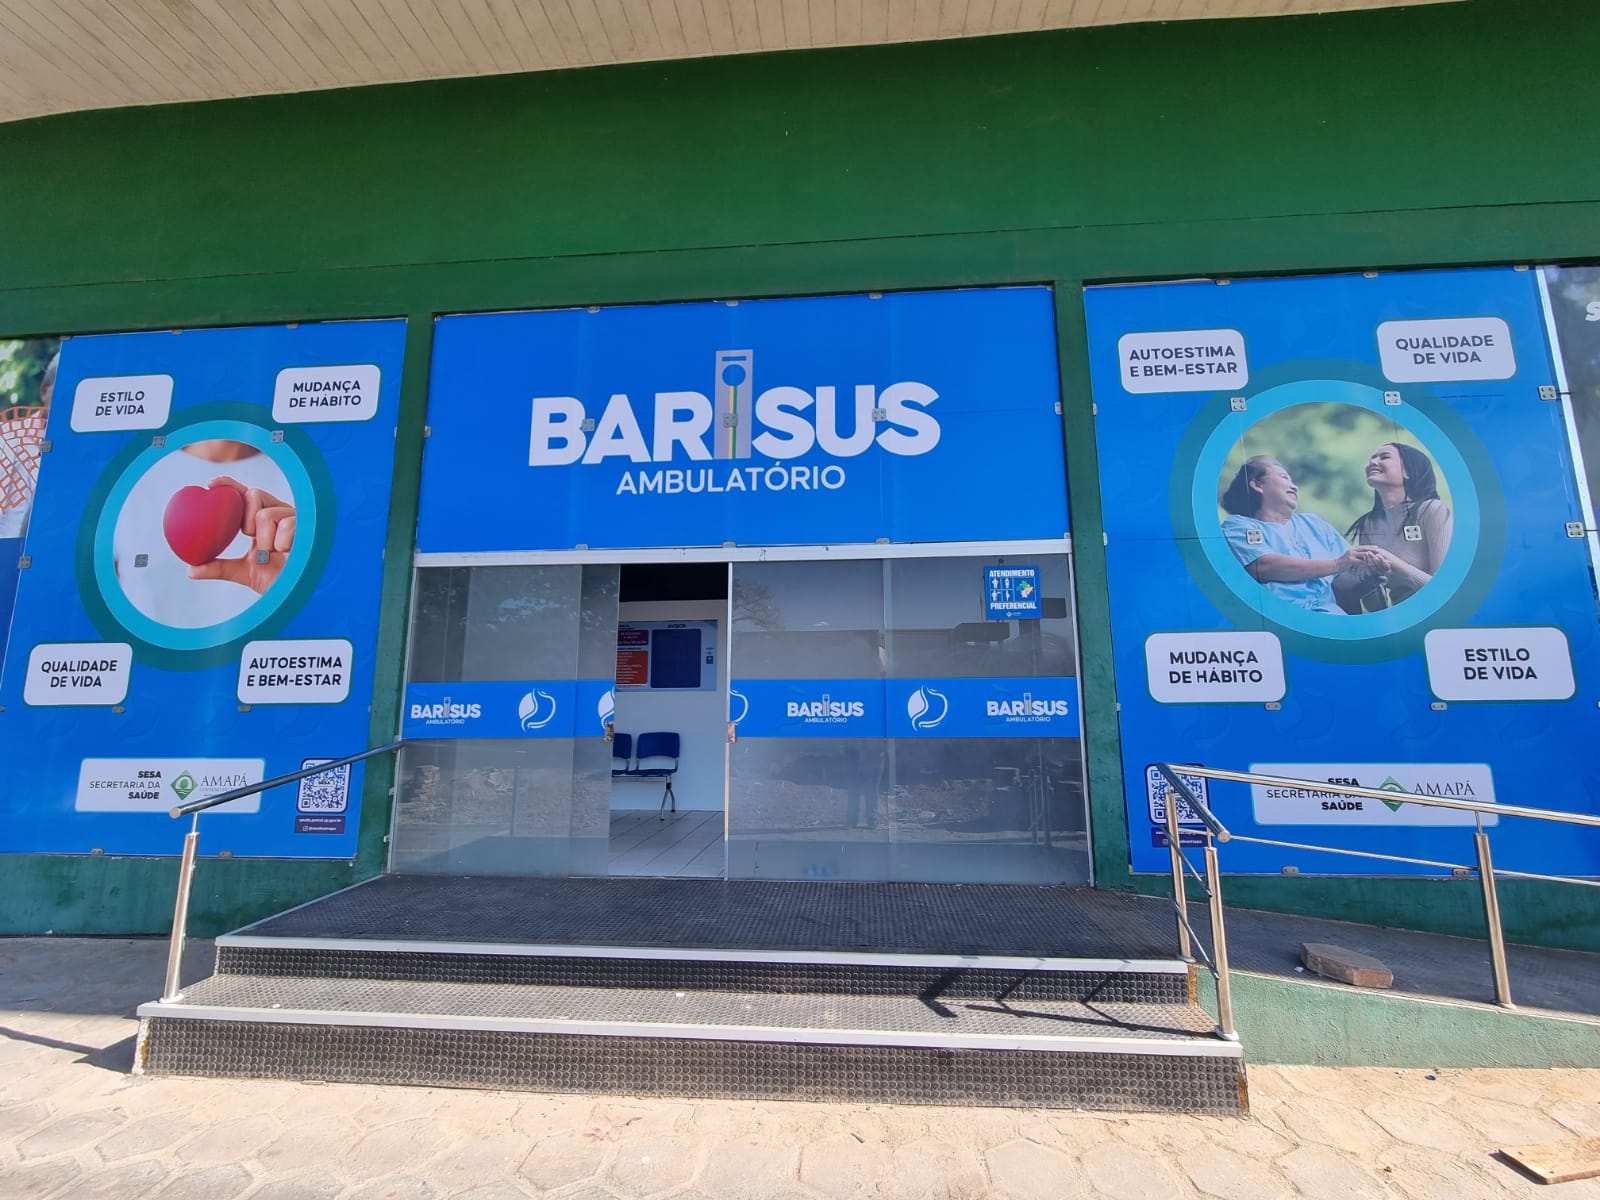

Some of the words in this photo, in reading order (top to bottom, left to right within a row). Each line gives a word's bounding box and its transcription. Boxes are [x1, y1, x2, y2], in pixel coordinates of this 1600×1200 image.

[1395, 335, 1494, 350] QUALIDADE
[1129, 346, 1235, 360] AUTOESTIMA
[1413, 353, 1436, 364] DE
[1440, 351, 1482, 364] VIDA
[1130, 366, 1139, 377] E
[1143, 362, 1237, 376] BEM-ESTAR
[293, 380, 360, 393] MUDANÇA
[100, 391, 145, 402] ESTILO
[289, 398, 306, 408] DE
[310, 394, 361, 407] HÁBITO
[95, 406, 112, 416] DE
[116, 404, 145, 415] VIDA
[616, 462, 846, 495] AMBULATÓRIO
[989, 569, 1035, 577] ATENDIMENTO
[990, 601, 1037, 610] PREFERENCIAL
[1169, 650, 1258, 667] MUDANÇA
[1464, 648, 1530, 661] ESTILO
[41, 660, 118, 673] QUALIDADE
[249, 656, 342, 669] AUTOESTIMA
[1169, 671, 1192, 683] DE
[1196, 667, 1263, 683] HÁBITO
[1463, 667, 1488, 680] DE
[1492, 666, 1538, 680] VIDA
[50, 676, 68, 687] DE
[71, 675, 102, 687] VIDA
[247, 675, 255, 686] E
[258, 674, 342, 686] BEM-ESTAR
[137, 770, 161, 778] SESA
[200, 772, 248, 787] AMAPÁ
[89, 781, 145, 789] SECRETARIA
[1414, 780, 1476, 796] AMAPÁ
[128, 790, 160, 799] SAÚDE
[1321, 800, 1364, 811] SAÚDE
